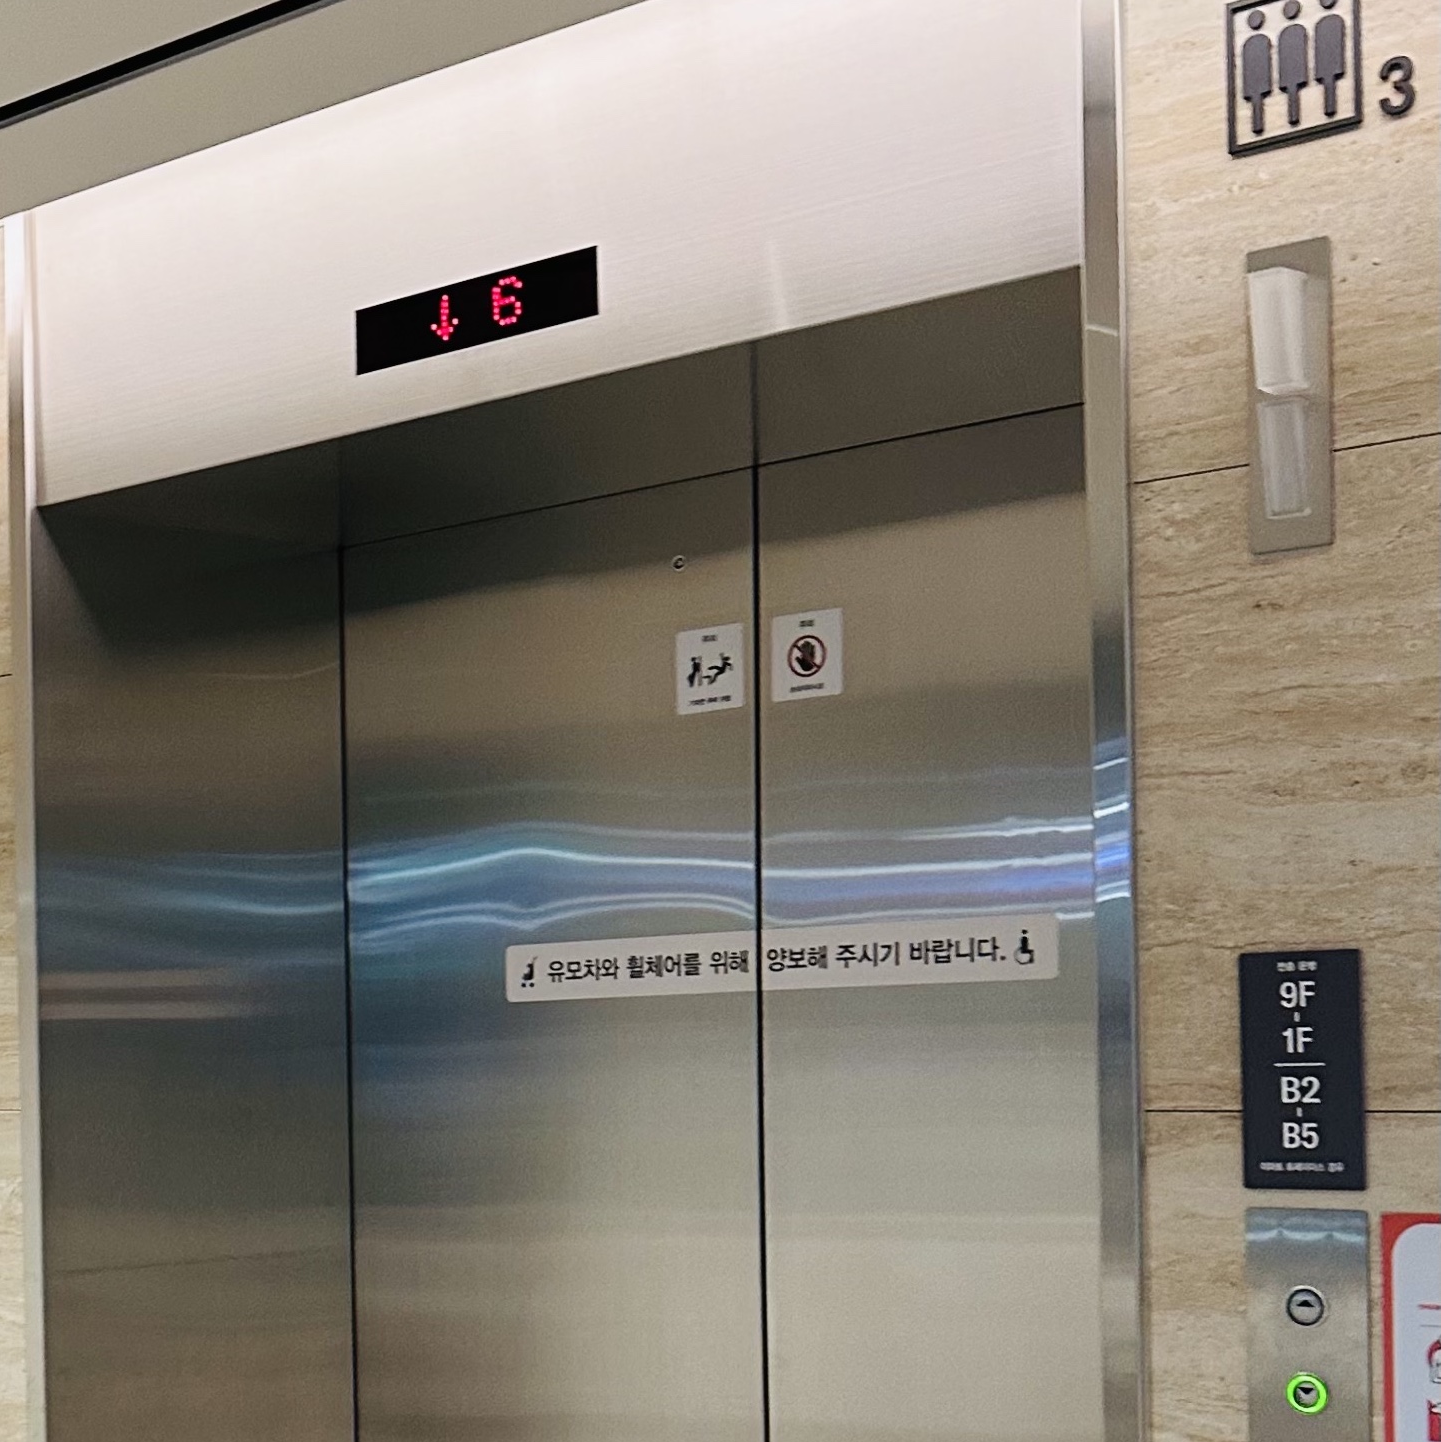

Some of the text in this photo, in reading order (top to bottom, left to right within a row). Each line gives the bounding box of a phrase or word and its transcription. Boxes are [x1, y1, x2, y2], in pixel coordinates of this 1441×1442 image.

[1379, 55, 1417, 117] 3
[491, 275, 524, 326] 6
[547, 936, 1007, 983] 유모차와 휠체어를 위해 양보해 주시기 바랍니다.
[1279, 980, 1316, 1009] 9F
[1282, 1026, 1314, 1054] 1F
[1281, 1076, 1322, 1104] B2
[1282, 1121, 1320, 1150] B5
